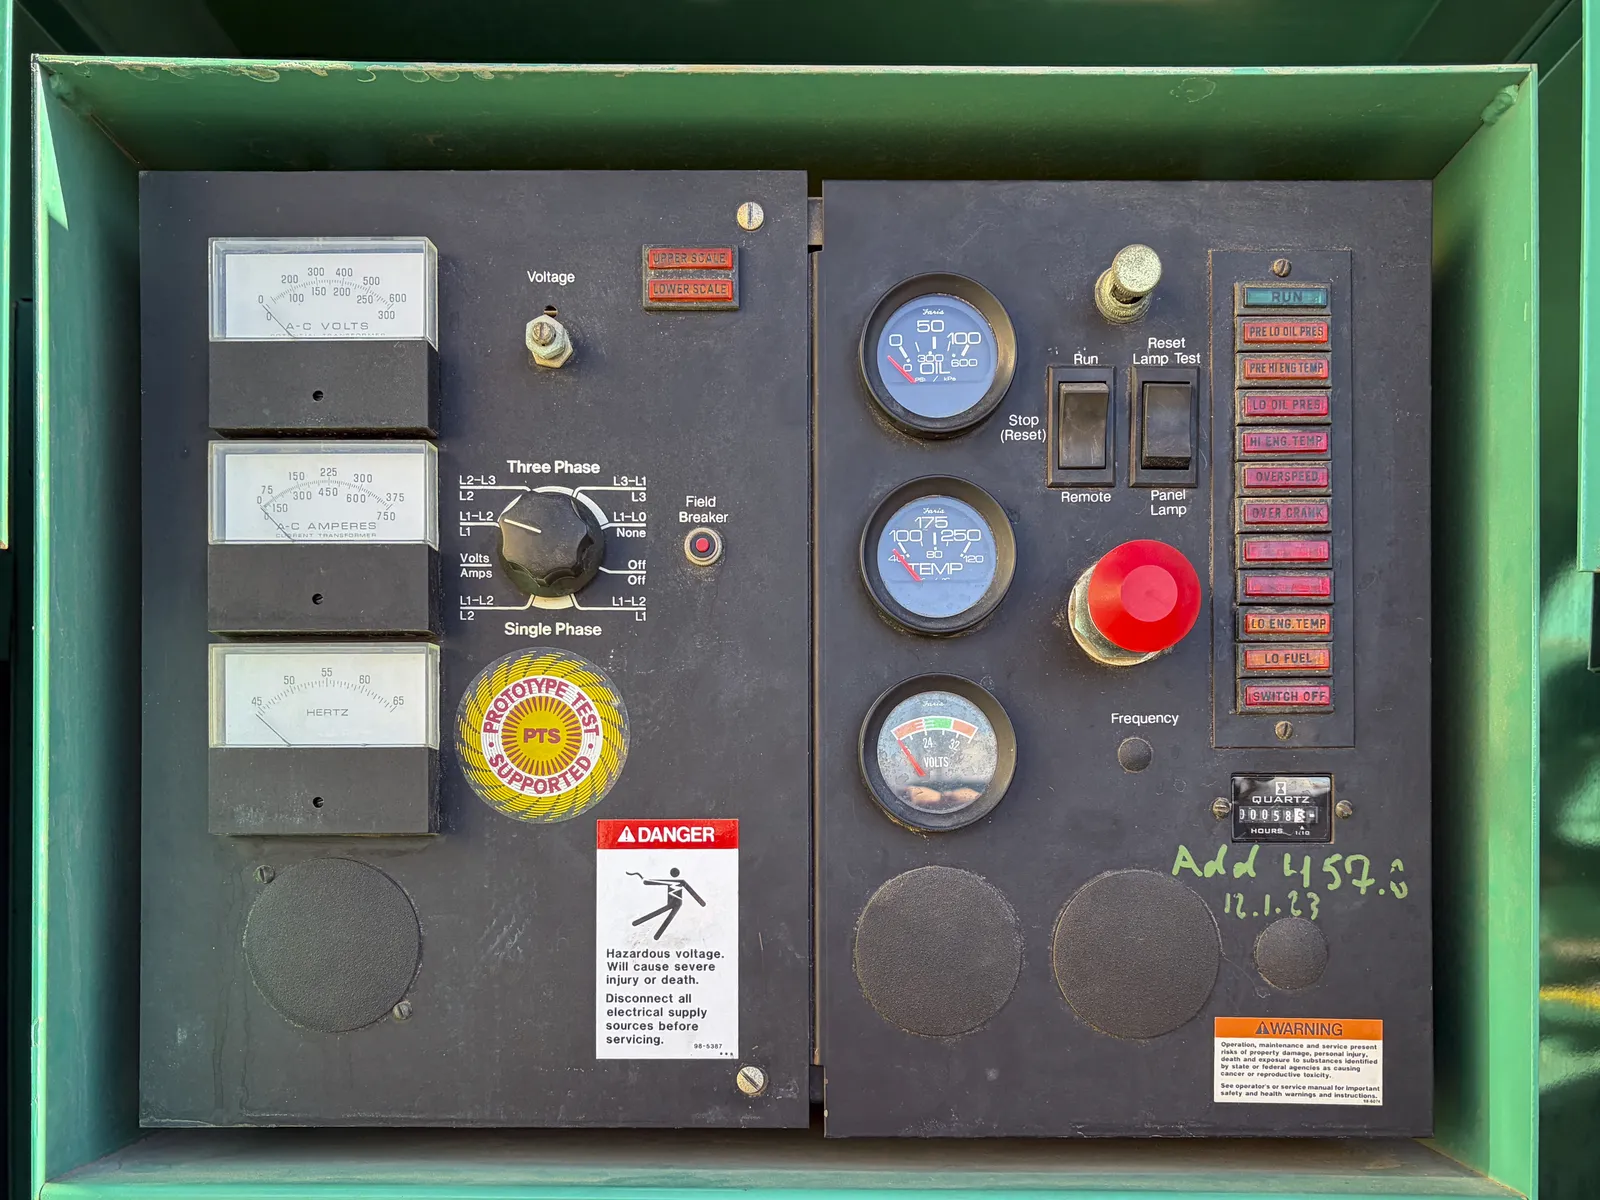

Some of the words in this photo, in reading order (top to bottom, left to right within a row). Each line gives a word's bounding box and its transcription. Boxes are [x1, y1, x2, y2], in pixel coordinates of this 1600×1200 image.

[653, 254, 687, 263] UPPER
[691, 253, 726, 264] SCALE
[527, 271, 575, 286] Voltage
[281, 275, 298, 284] 200
[308, 268, 324, 276] 300
[336, 268, 353, 277] 400
[363, 277, 380, 285] 500
[390, 294, 406, 302] 600
[653, 284, 689, 295] LOWER
[693, 284, 727, 294] SCALE
[1272, 292, 1303, 302] RUN
[289, 294, 304, 302] 100
[312, 287, 326, 296] 150
[334, 288, 350, 296] 200
[357, 295, 373, 304] 250
[378, 311, 395, 319] 300
[889, 334, 902, 346] 0
[917, 320, 944, 332] 50
[947, 332, 981, 345] 100
[1250, 327, 1266, 336] PRE
[1270, 327, 1280, 336] LO
[1283, 327, 1297, 336] OIL
[1300, 327, 1323, 336] PRES
[1148, 338, 1186, 349] Reset
[951, 359, 978, 367] 600
[1074, 354, 1098, 365] Run
[1133, 354, 1169, 366] Lamp
[1174, 353, 1201, 364] Test
[920, 362, 950, 374] OIL
[1250, 363, 1266, 373] PRE
[1269, 363, 1277, 373] HI
[1272, 400, 1288, 410] OIL
[1293, 400, 1320, 410] PRES
[1009, 415, 1039, 427] Stop
[1000, 430, 1047, 443] (Reset)
[1250, 437, 1260, 447] HI
[507, 460, 551, 473] Three
[554, 460, 600, 474] Phase
[460, 475, 496, 485] L2-L3
[614, 476, 646, 486] L3-L1
[1256, 471, 1318, 481] OVERSPEED
[262, 486, 273, 494] 75
[289, 472, 305, 481] 150
[320, 468, 337, 476] 225
[354, 474, 372, 483] 300
[386, 493, 404, 502] 375
[460, 491, 474, 501] L2
[632, 492, 646, 502] L3
[1061, 492, 1111, 503] Remote
[1151, 490, 1186, 501] Panel
[273, 504, 288, 513] 150
[293, 492, 312, 500] 300
[319, 488, 338, 496] 450
[347, 494, 366, 503] 600
[377, 512, 396, 521] 750
[686, 496, 716, 507] Field
[460, 512, 494, 521] L1-L2
[1151, 505, 1187, 517] Lamp
[1253, 508, 1281, 518] OVER
[1286, 508, 1323, 518] CRANK
[679, 512, 728, 522] Breaker
[460, 527, 470, 536] L1
[617, 528, 646, 537] None
[889, 530, 922, 542] 100
[915, 516, 948, 529] 175
[941, 530, 981, 542] 250
[460, 554, 490, 563] Volts
[963, 555, 984, 563] 120
[628, 560, 646, 569] Off
[908, 563, 963, 575] TEMP
[460, 568, 492, 579] Amps
[628, 576, 646, 585] Off
[460, 596, 494, 605] L1-L2
[612, 597, 646, 606] L1-L2
[460, 611, 474, 621] L2
[636, 612, 646, 621] L1
[1252, 619, 1264, 628] LO
[505, 622, 551, 638] Single
[556, 623, 602, 636] Phase
[1265, 654, 1279, 663] LO
[1285, 653, 1312, 663] FUEL
[252, 697, 262, 706] 45
[284, 676, 295, 685] 50
[321, 668, 332, 677] 55
[359, 675, 370, 684] 60
[393, 697, 404, 705] 65
[1253, 692, 1298, 701] SWITCH
[1304, 692, 1326, 701] OFF
[483, 678, 569, 733] PROTOTYPE
[571, 692, 599, 736] TEST
[1111, 713, 1179, 726] Frequency
[524, 728, 561, 743] PTS
[923, 737, 932, 748] 24
[949, 739, 960, 750] 32
[924, 757, 949, 767] VOLTS
[489, 754, 591, 794] SUPPORTED
[1252, 796, 1310, 804] QUARTZ
[638, 827, 715, 843] DANGER
[1172, 844, 1260, 878] Add
[606, 949, 670, 958] Hazardous
[676, 949, 724, 960] voltage.
[607, 962, 628, 971] Will
[633, 963, 669, 971] cause
[606, 975, 639, 986] injury
[661, 975, 699, 984] death.
[606, 993, 673, 1003] Disconnect
[679, 994, 692, 1003] all
[607, 1007, 663, 1017] electrical
[668, 1008, 707, 1019] supply
[606, 1022, 653, 1030] sources
[659, 1021, 699, 1031] before
[1270, 1022, 1342, 1036] WARNING
[606, 1035, 664, 1046] servicing.
